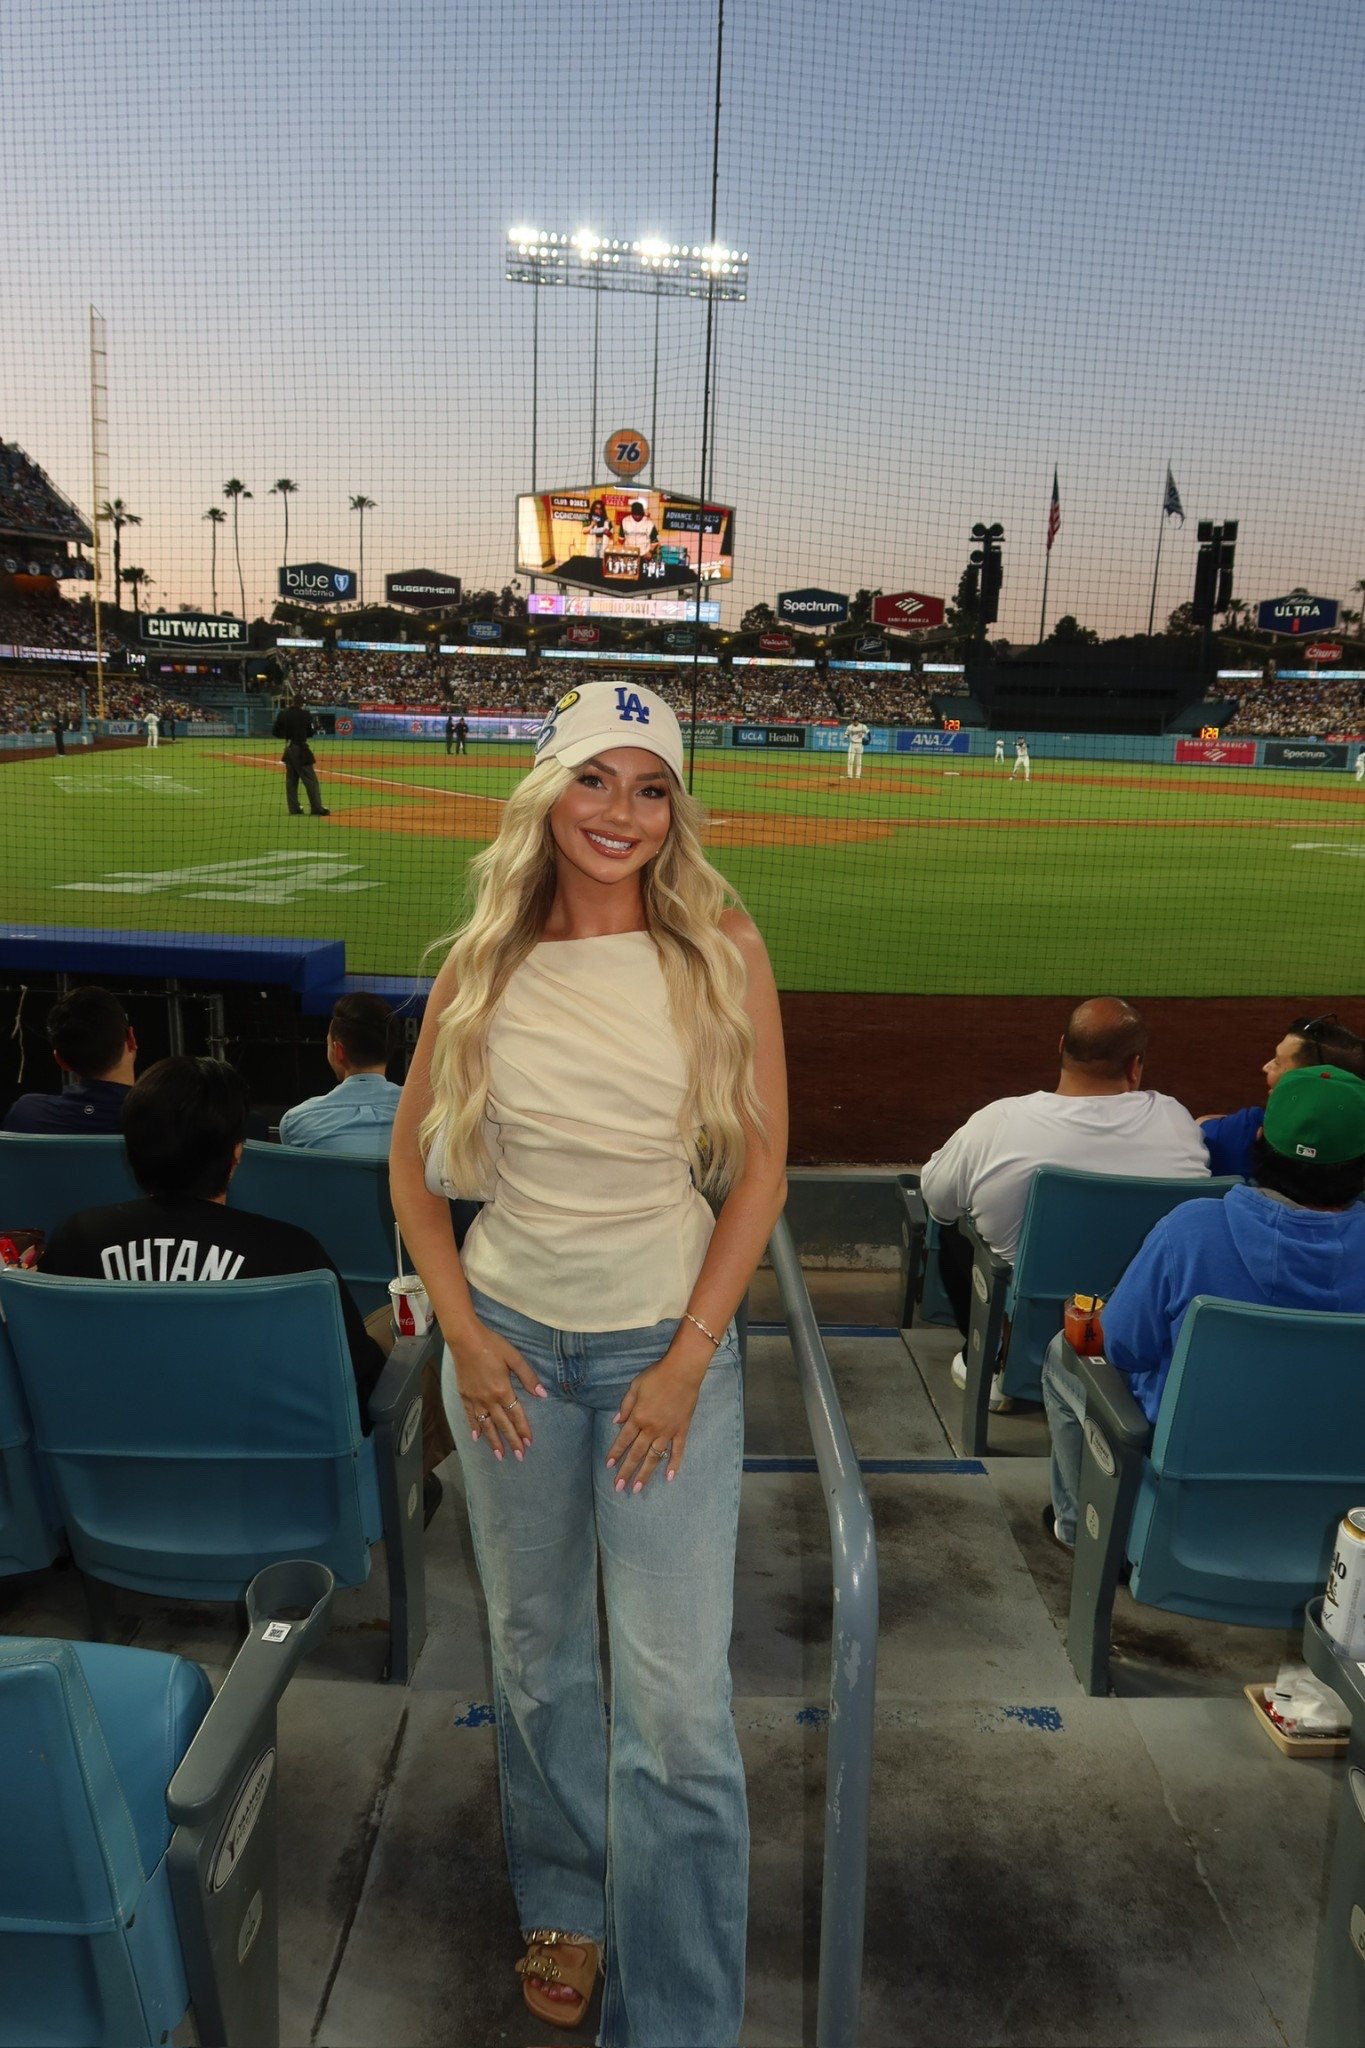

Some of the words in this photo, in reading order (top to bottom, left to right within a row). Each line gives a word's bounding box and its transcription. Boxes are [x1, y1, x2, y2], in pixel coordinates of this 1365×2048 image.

[616, 442, 641, 463] 76
[286, 568, 329, 589] blue
[391, 584, 456, 595] GUGGENHEIM
[783, 599, 840, 613] Spectrum
[1274, 605, 1321, 617] ULTRA
[148, 619, 240, 639] CUTWATER
[614, 687, 650, 724] LA
[741, 732, 763, 741] UCLA
[768, 732, 800, 743] Health
[911, 733, 940, 746] ANA
[1283, 749, 1325, 759] Spectrum
[101, 1238, 245, 1282] OHTANI
